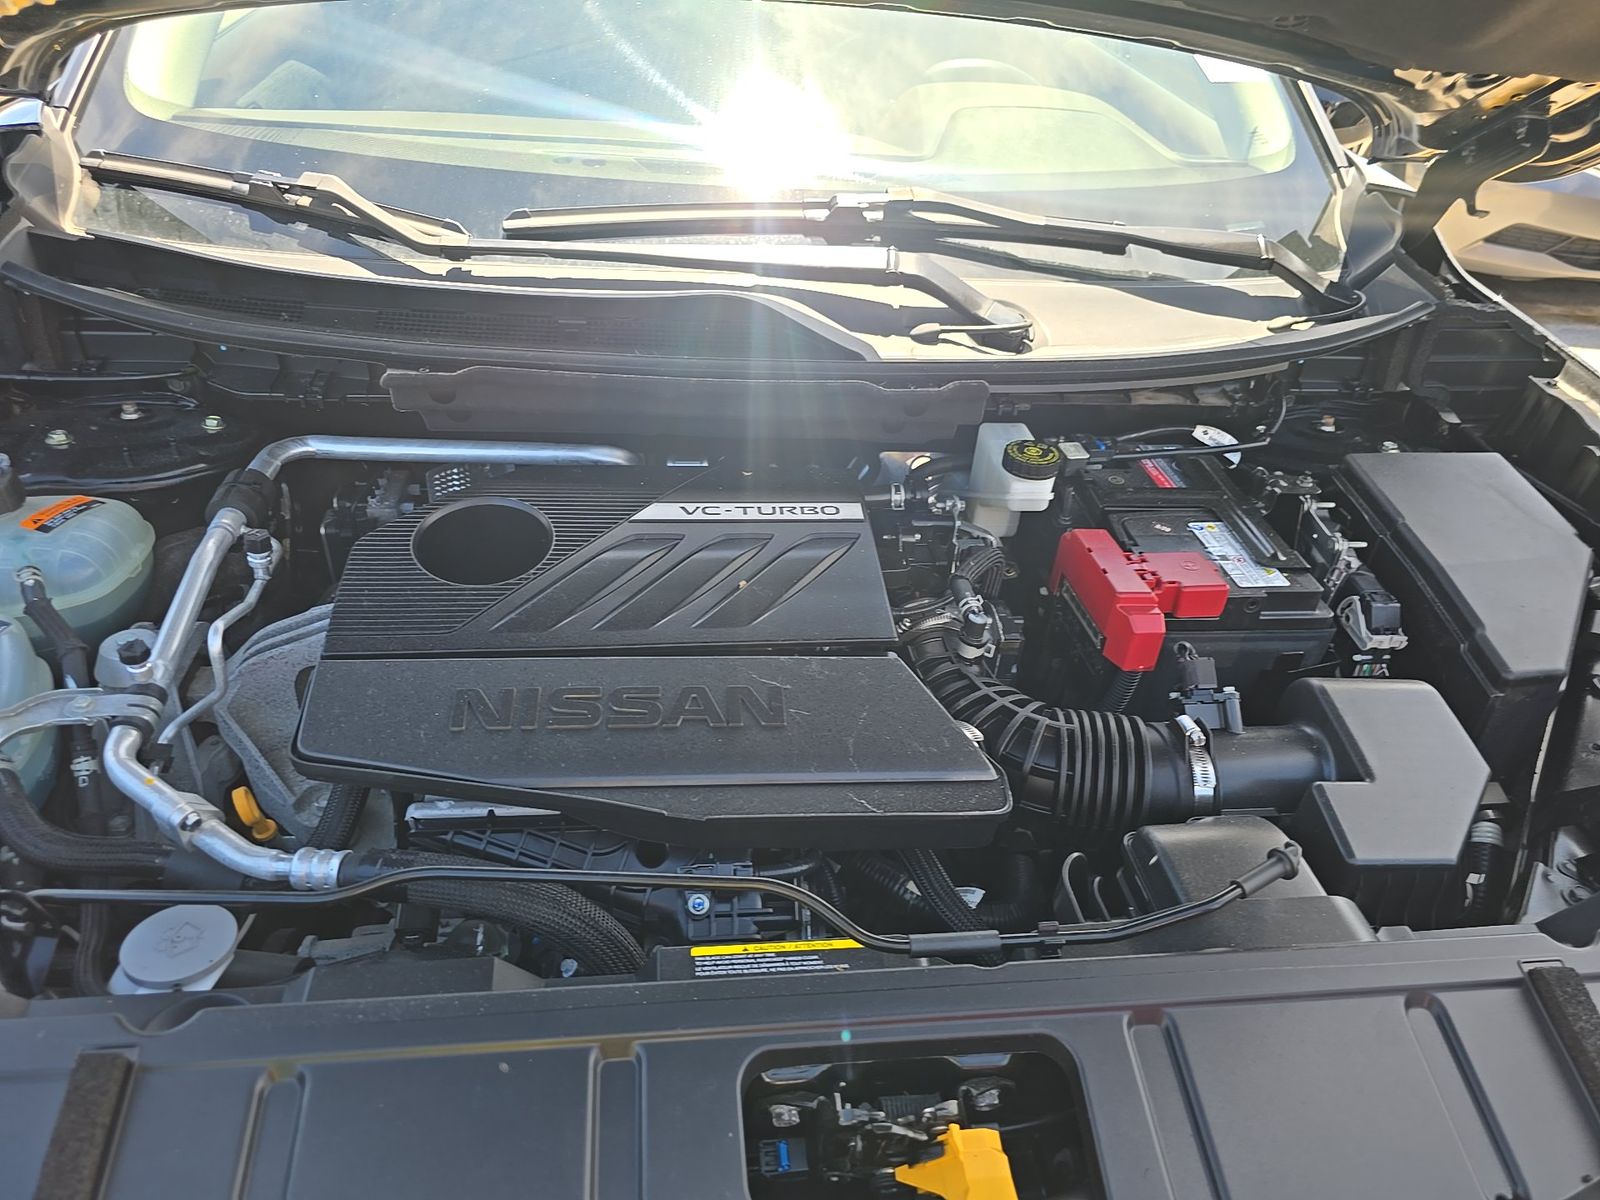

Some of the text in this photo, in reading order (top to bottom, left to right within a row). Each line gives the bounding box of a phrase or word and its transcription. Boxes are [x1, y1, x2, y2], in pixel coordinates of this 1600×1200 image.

[679, 505, 841, 516] VC-TURBO
[449, 685, 787, 732] NISSAN
[753, 944, 786, 952] CAUTION
[794, 942, 833, 950] ATTENTION
